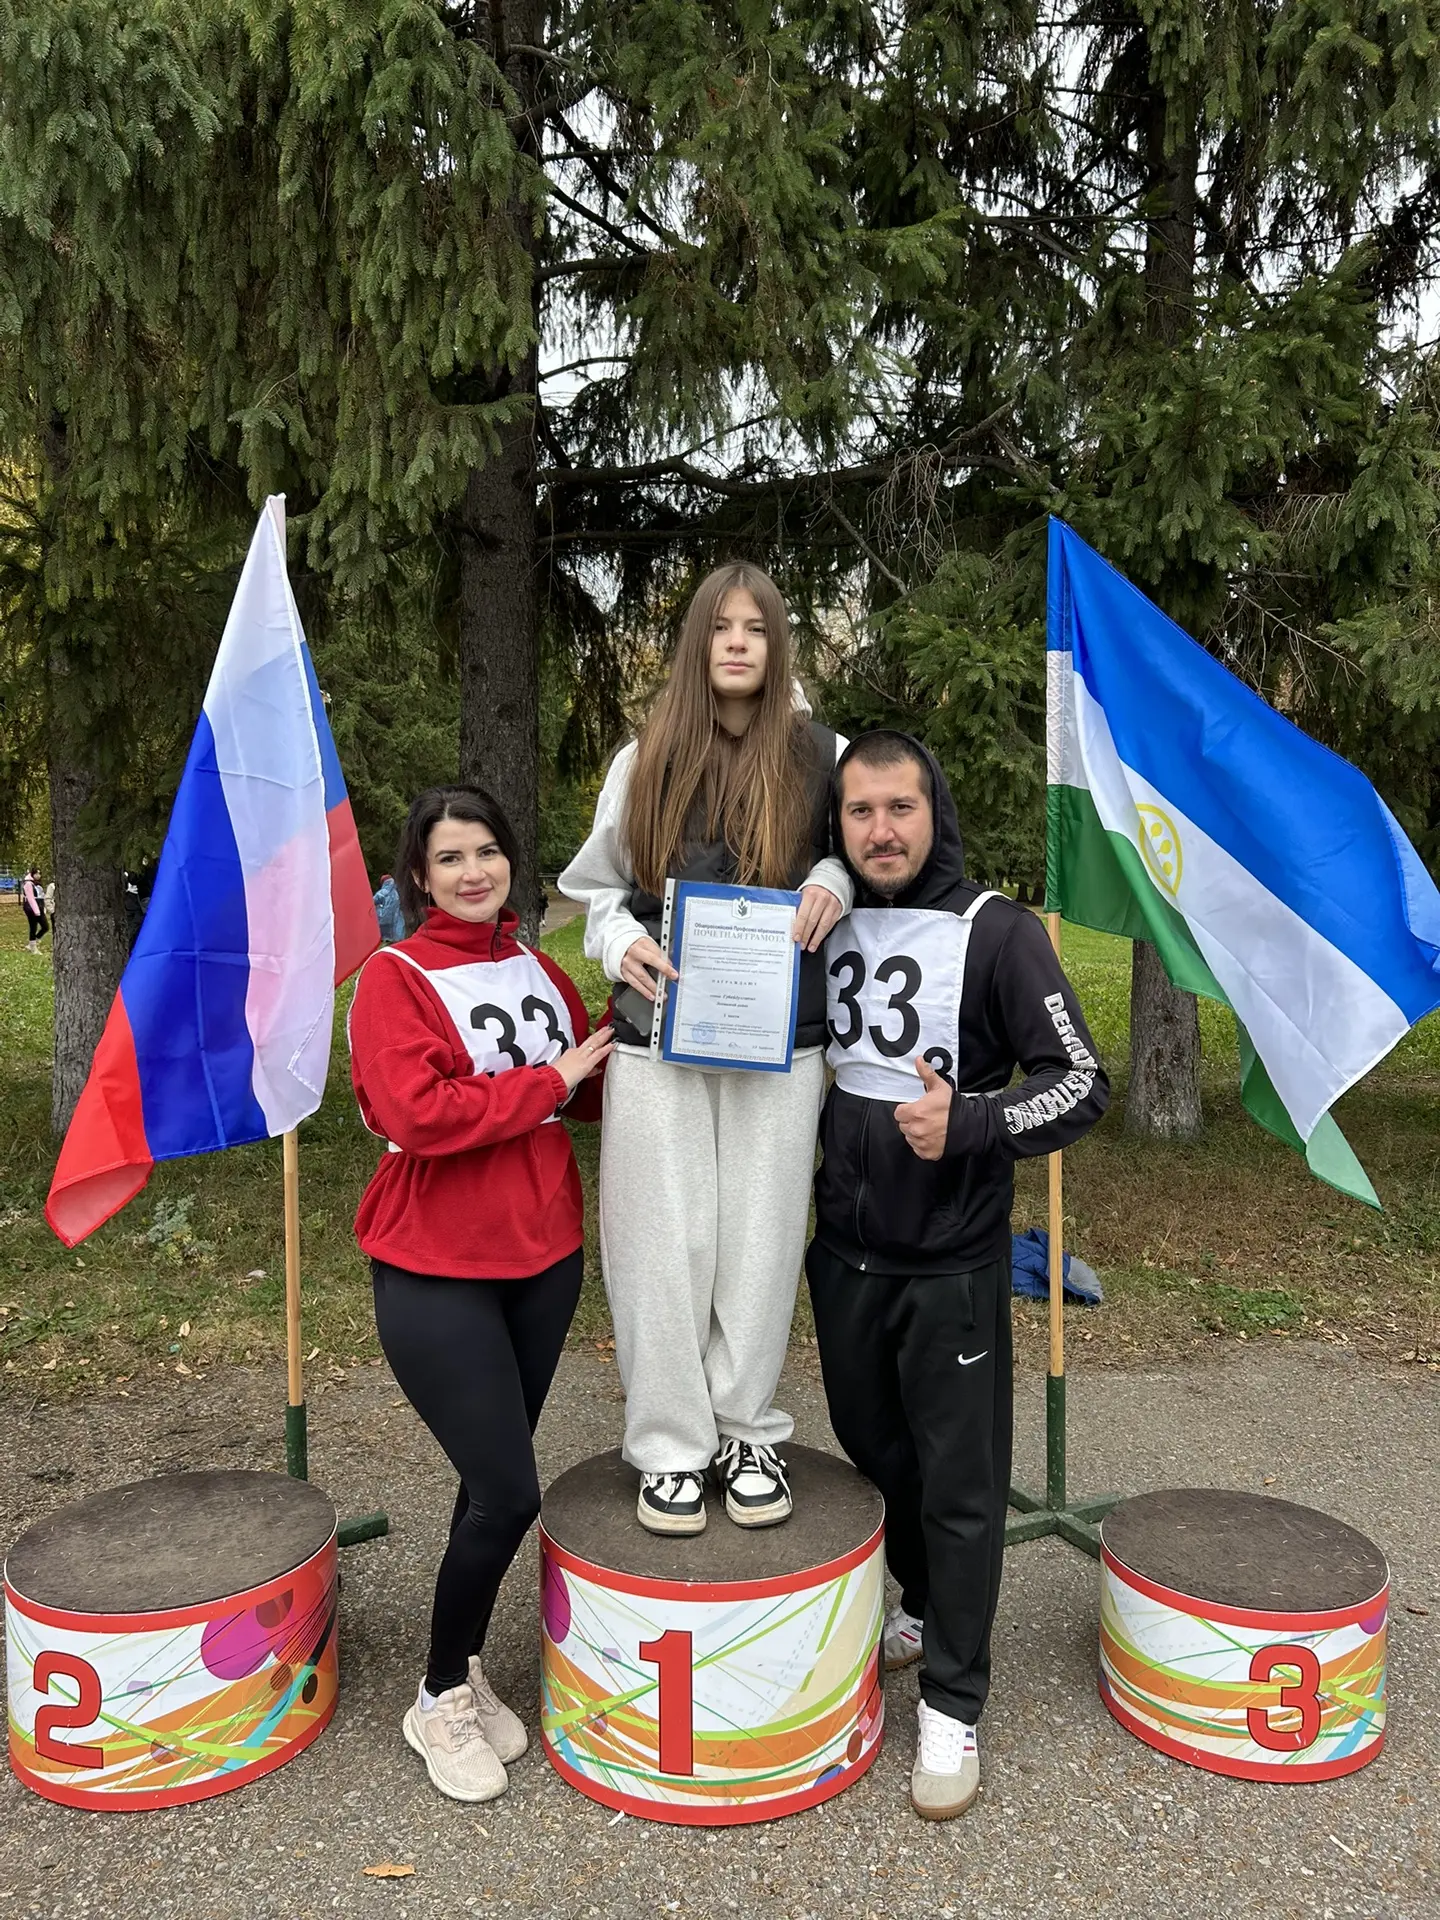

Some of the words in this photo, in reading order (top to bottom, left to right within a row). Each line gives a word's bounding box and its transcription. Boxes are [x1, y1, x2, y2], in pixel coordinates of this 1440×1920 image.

[744, 932, 786, 943] ГРАМОТА
[470, 994, 569, 1079] 33
[827, 950, 923, 1058] 33
[1043, 991, 1098, 1070] DEMIX
[32, 1650, 104, 1769] 2
[639, 1629, 694, 1776] 1
[1246, 1644, 1322, 1752] 3
